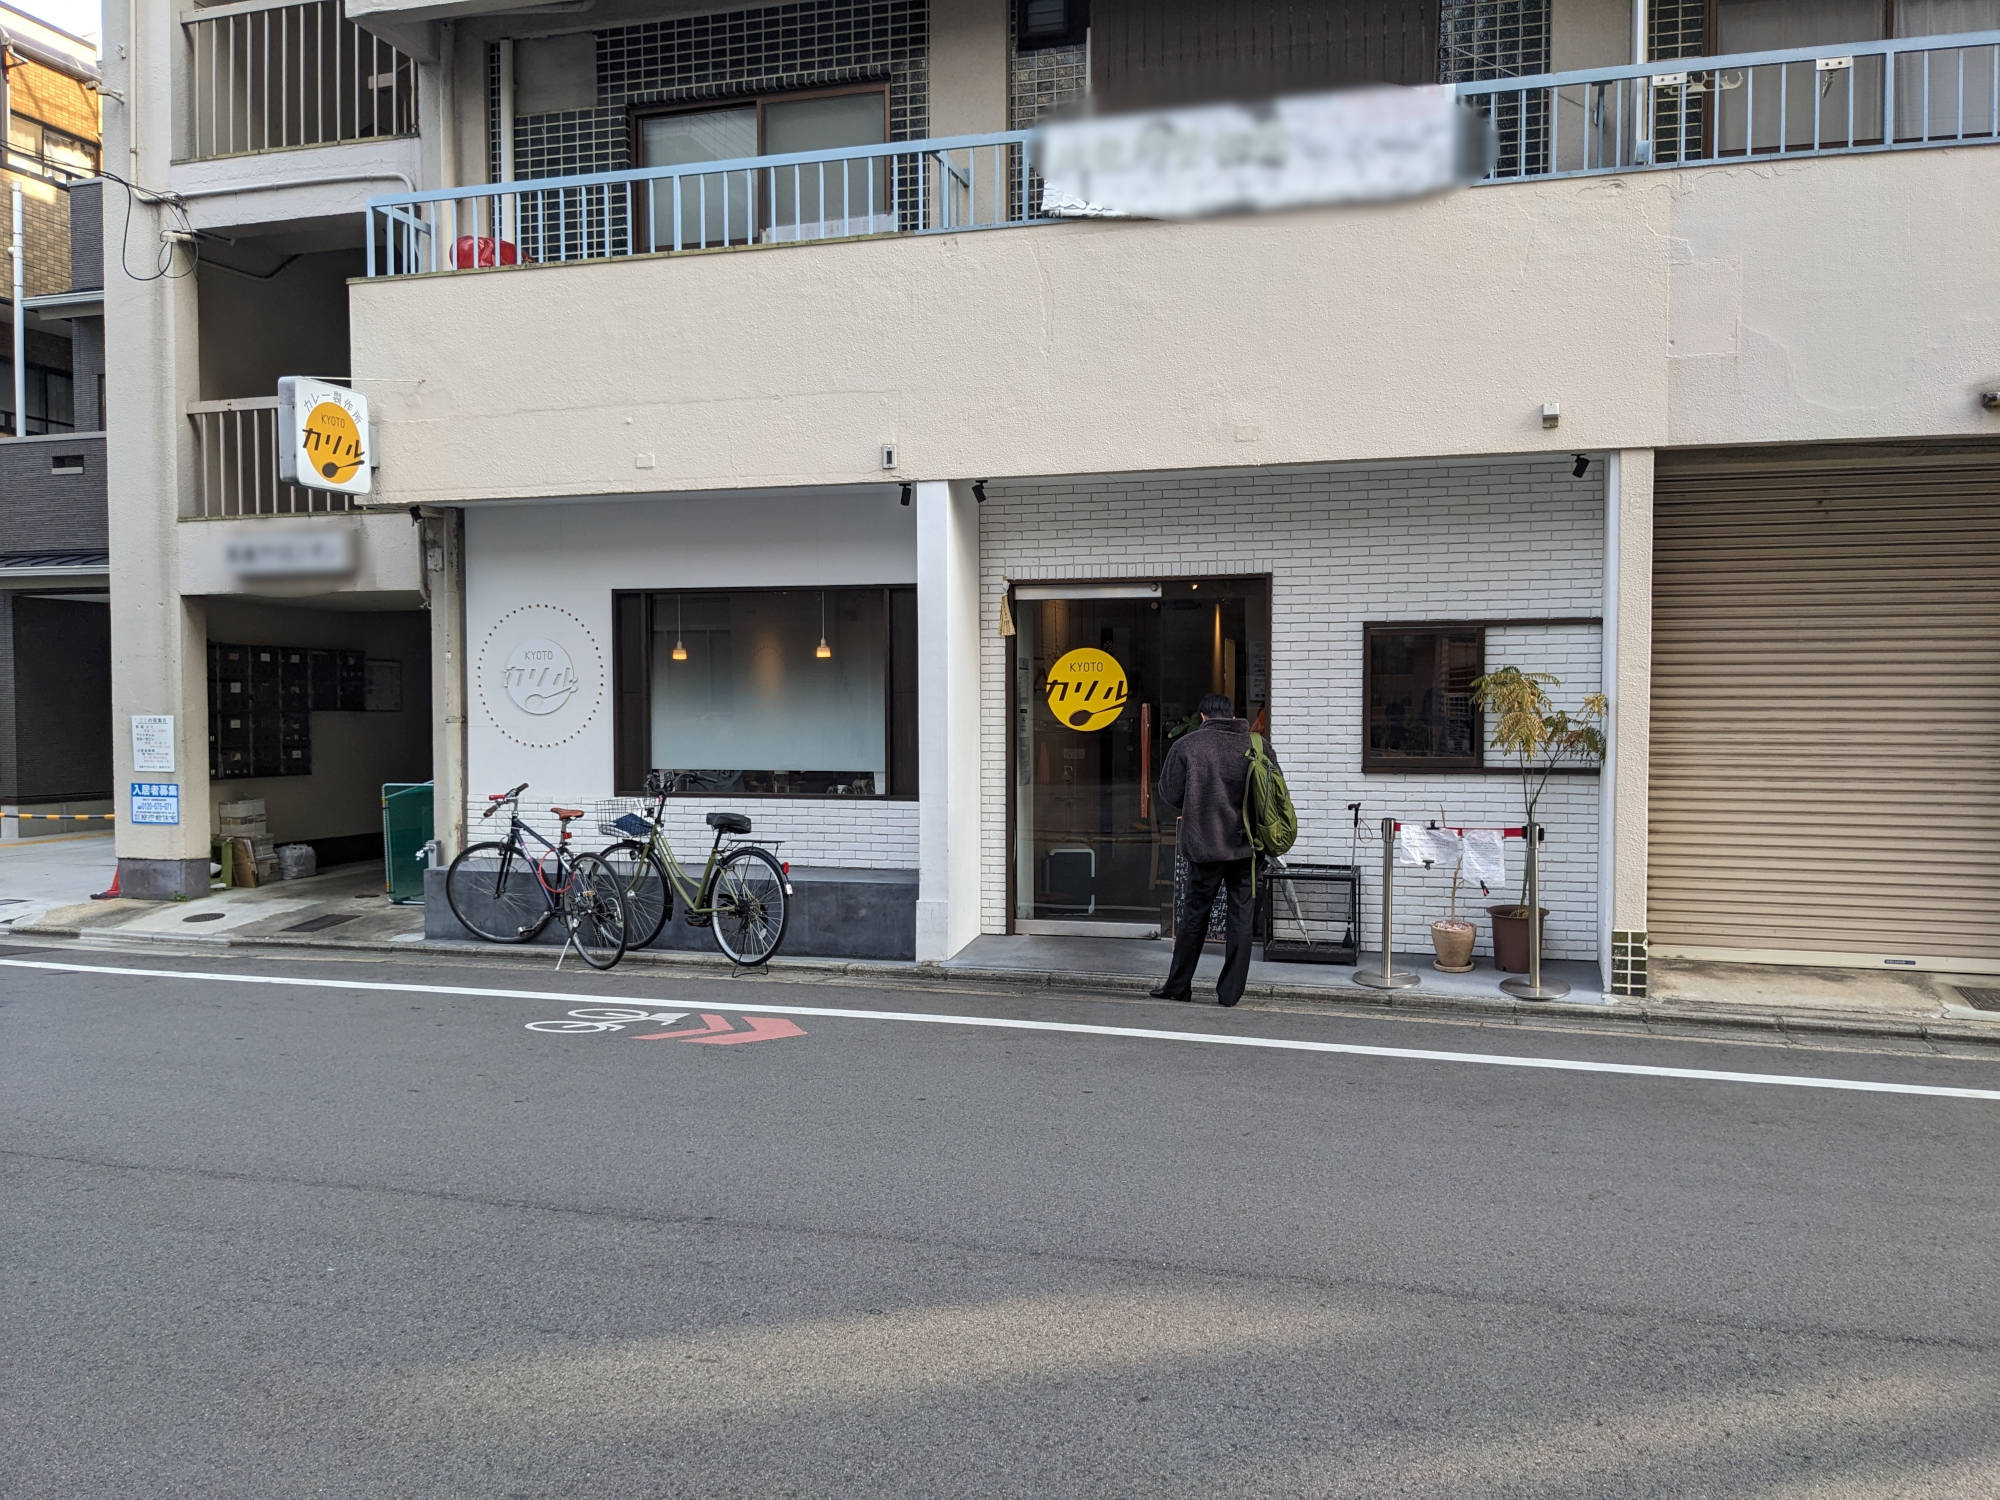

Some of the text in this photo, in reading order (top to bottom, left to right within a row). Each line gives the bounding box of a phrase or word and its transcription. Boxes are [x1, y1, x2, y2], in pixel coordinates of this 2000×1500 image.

[304, 391, 363, 424] カレー製作所
[321, 414, 346, 429] KYOTO
[302, 428, 365, 458] カリル
[524, 650, 553, 661] KYOTO
[504, 666, 579, 688] カリル
[1069, 661, 1104, 673] KYOTO
[1045, 679, 1129, 702] カリル
